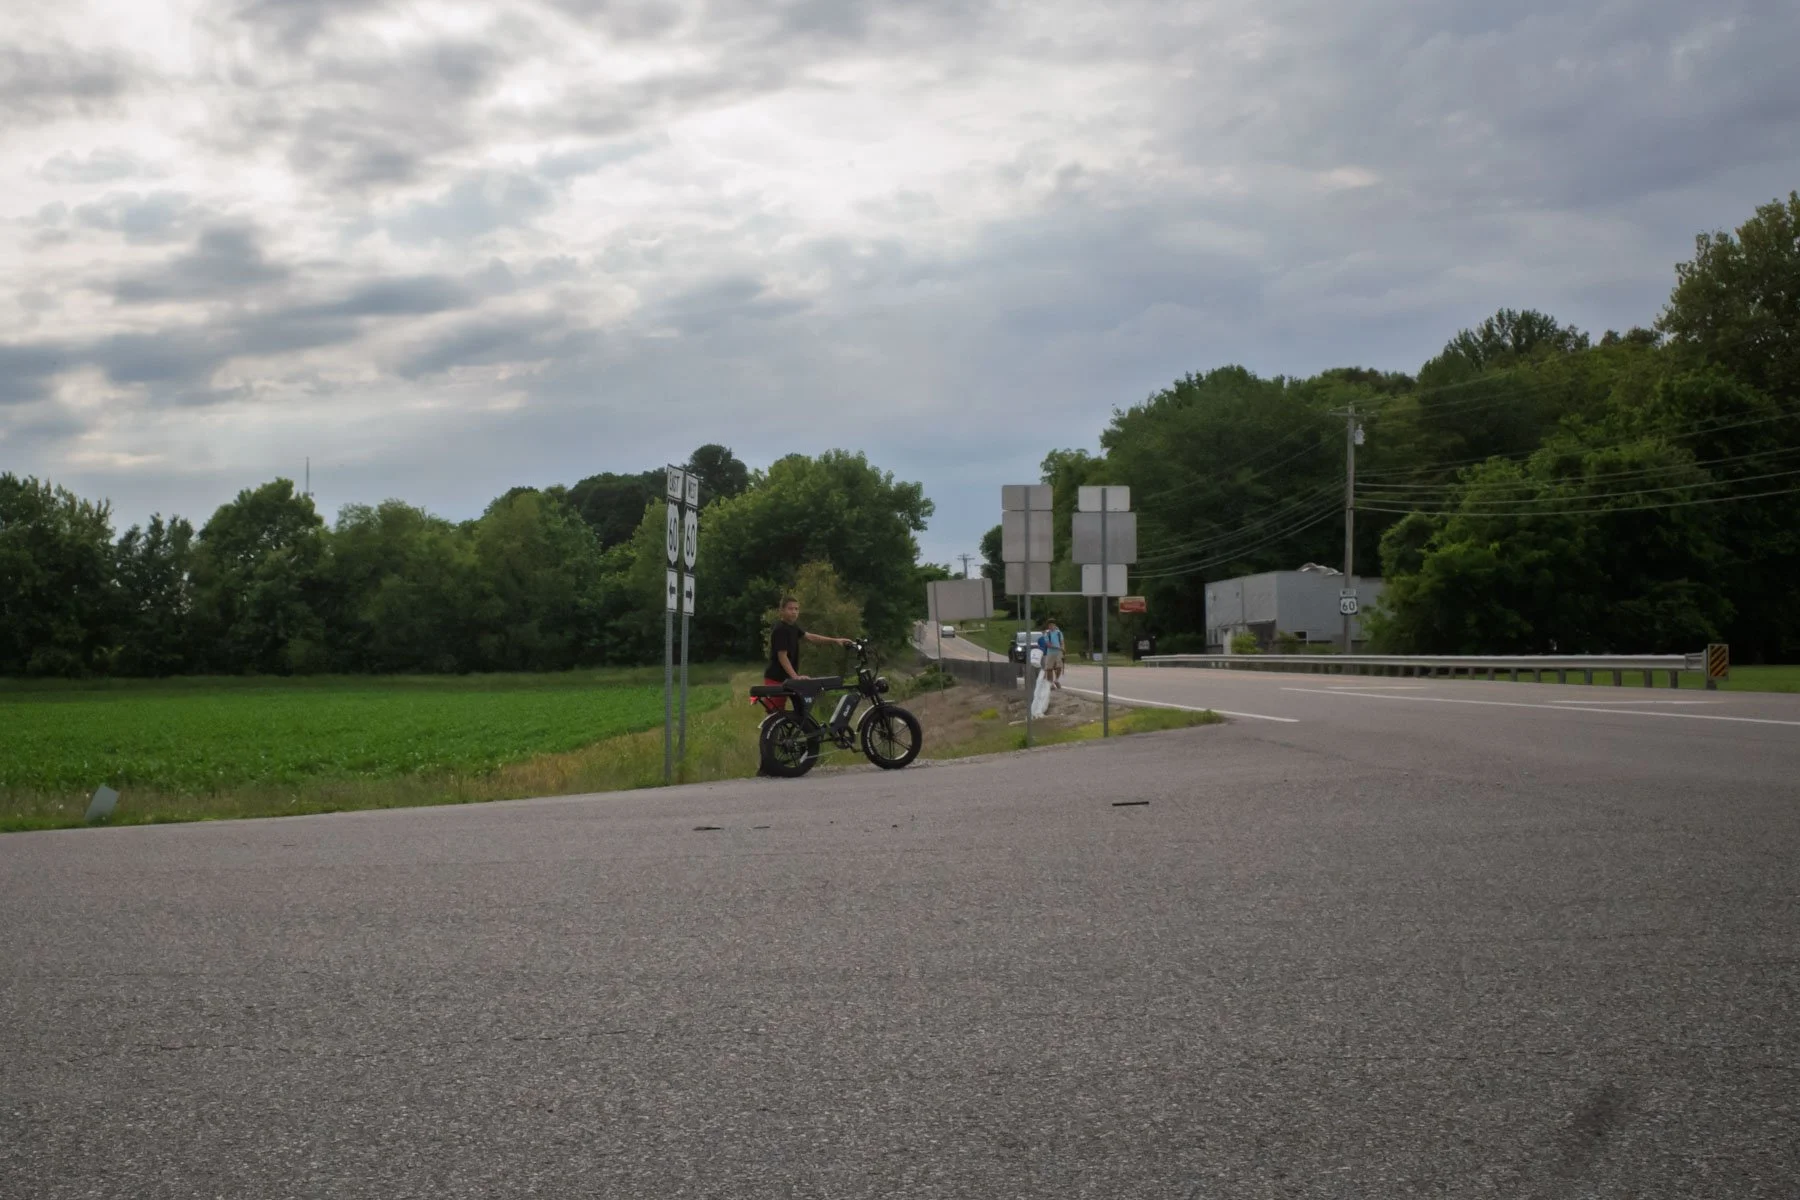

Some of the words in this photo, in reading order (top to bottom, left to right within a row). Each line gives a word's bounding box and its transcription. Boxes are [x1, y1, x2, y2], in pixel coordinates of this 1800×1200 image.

[669, 471, 680, 492] EAST
[687, 479, 697, 499] WEST
[668, 517, 678, 552] 60
[686, 523, 696, 558] 60
[1342, 600, 1356, 612] 60
